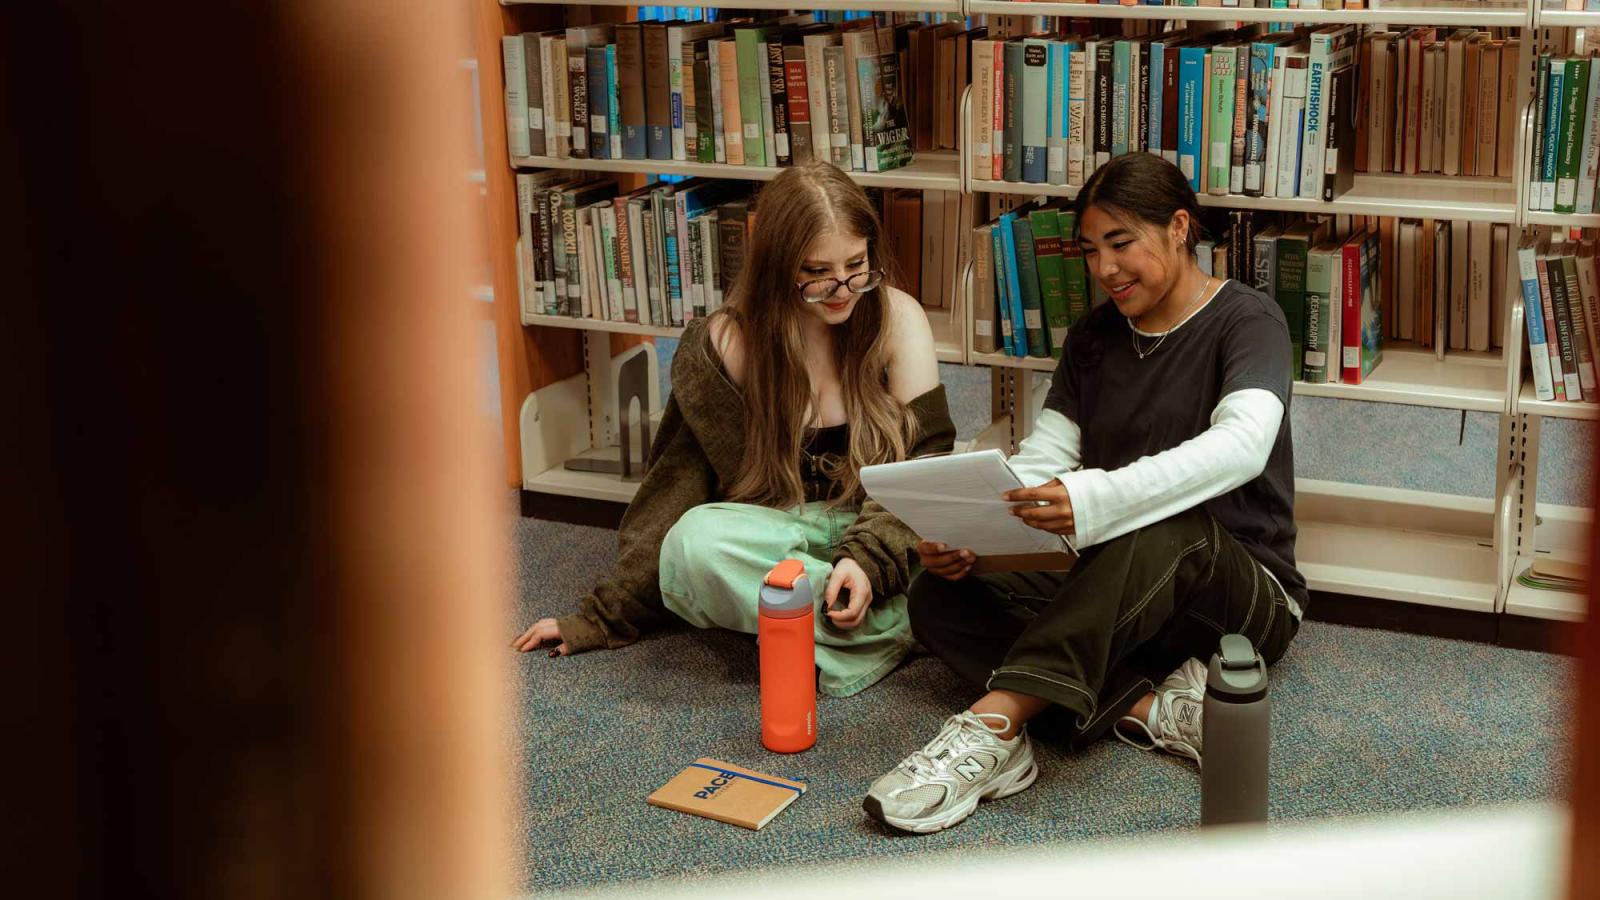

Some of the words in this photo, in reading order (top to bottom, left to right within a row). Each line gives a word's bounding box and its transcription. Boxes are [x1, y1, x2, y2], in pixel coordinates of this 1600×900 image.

[768, 43, 783, 65] LOST
[770, 66, 784, 78] AT
[771, 79, 785, 94] SEA
[828, 60, 839, 116] COLLISION
[1308, 63, 1322, 132] EARTHSHOCK
[573, 86, 581, 121] WORLD
[1549, 87, 1559, 132] ENVIRONMENTAL
[832, 119, 840, 161] COSE
[877, 127, 909, 145] WAGER
[1251, 114, 1259, 161] ENVIRONMENTAL
[1548, 133, 1556, 151] POLICY
[1546, 152, 1555, 177] PARADOX
[539, 203, 547, 230] HEART
[550, 193, 561, 224] Dove
[541, 237, 549, 253] SEA
[562, 209, 576, 254] KODOKU
[1255, 258, 1270, 289] SEA
[1308, 295, 1320, 350] OCEANOGRAPHY
[1554, 286, 1563, 317] NATURE
[1559, 320, 1572, 361] UNFURLED
[1570, 307, 1585, 335] RISING
[955, 756, 985, 782] N
[694, 772, 736, 799] PACE
